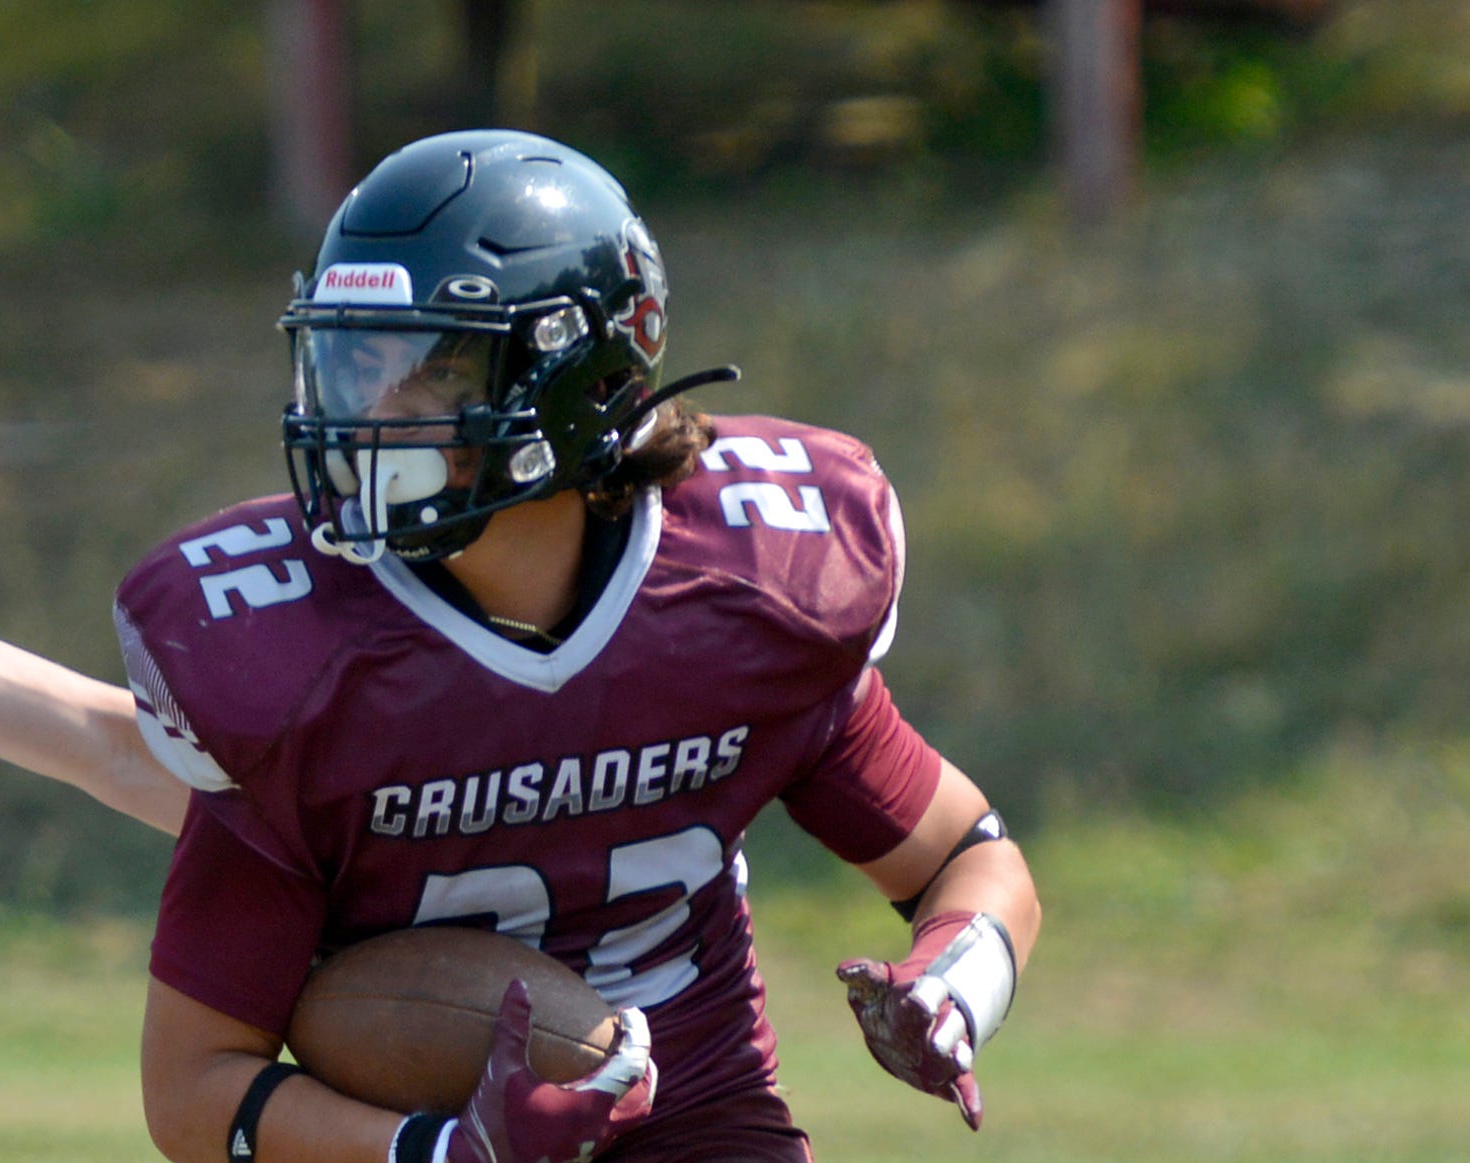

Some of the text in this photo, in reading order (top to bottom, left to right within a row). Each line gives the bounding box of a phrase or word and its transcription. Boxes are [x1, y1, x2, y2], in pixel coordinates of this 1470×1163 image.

[326, 269, 396, 289] Riddell
[700, 436, 831, 532] 22
[179, 517, 312, 619] 22
[370, 725, 750, 838] CRUSADERS
